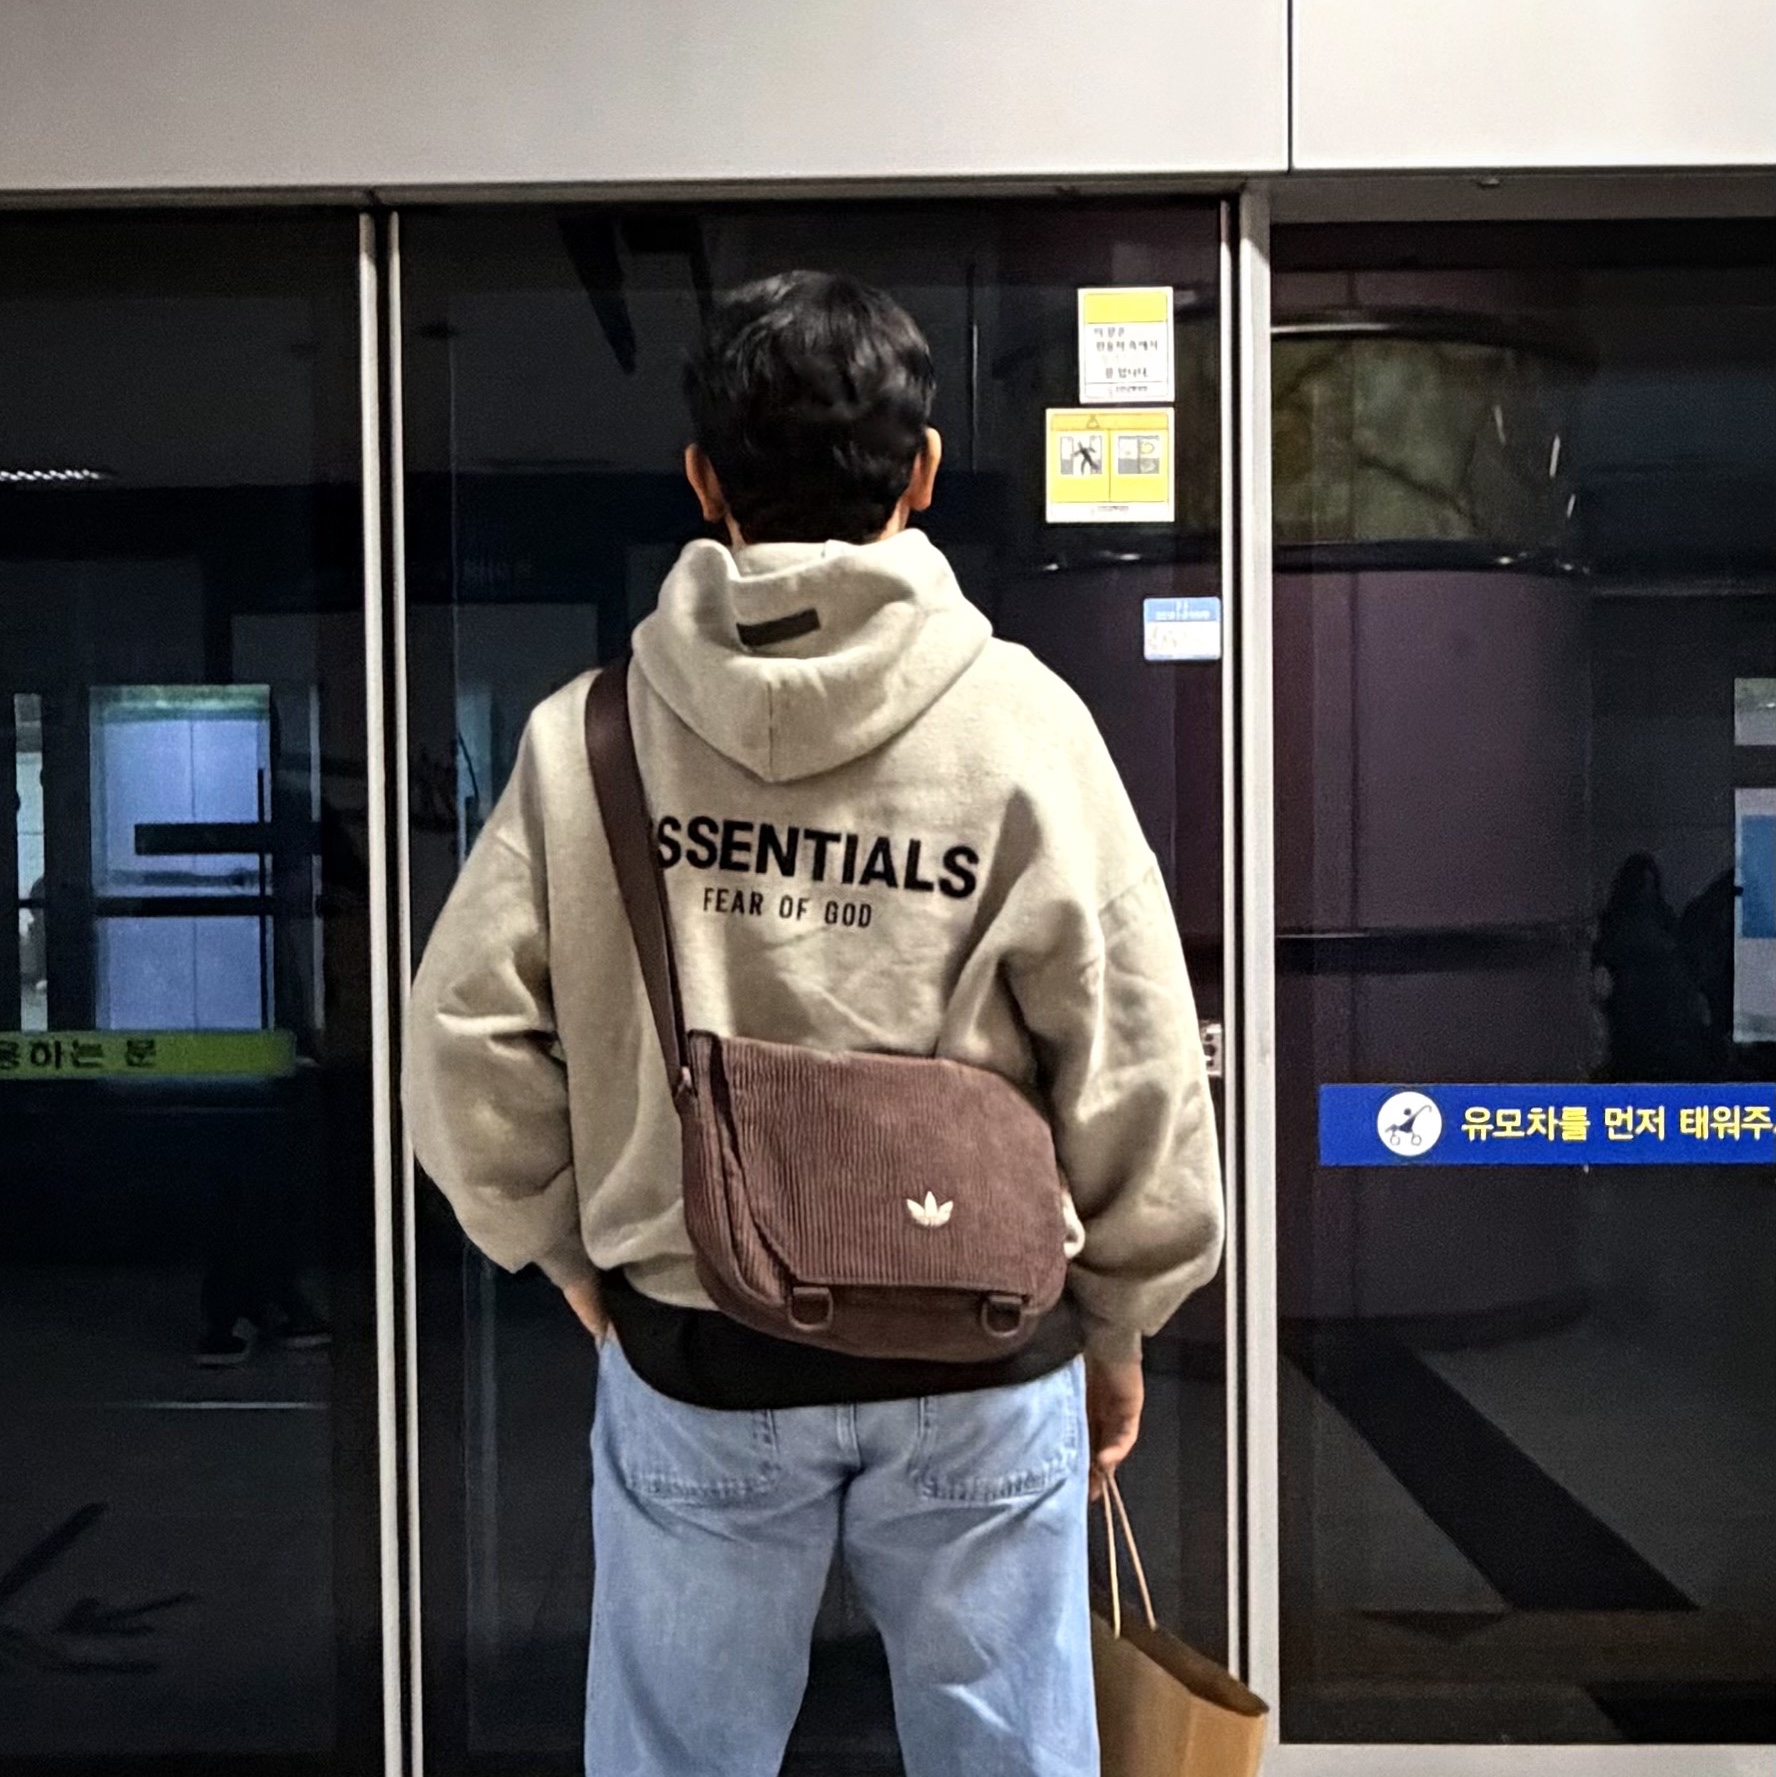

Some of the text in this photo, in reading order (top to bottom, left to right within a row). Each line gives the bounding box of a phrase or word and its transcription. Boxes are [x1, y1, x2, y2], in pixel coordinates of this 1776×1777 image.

[702, 887, 872, 929] FEAR OF GOD
[1461, 1105, 1776, 1142] 유모차를 먼저 태워주
